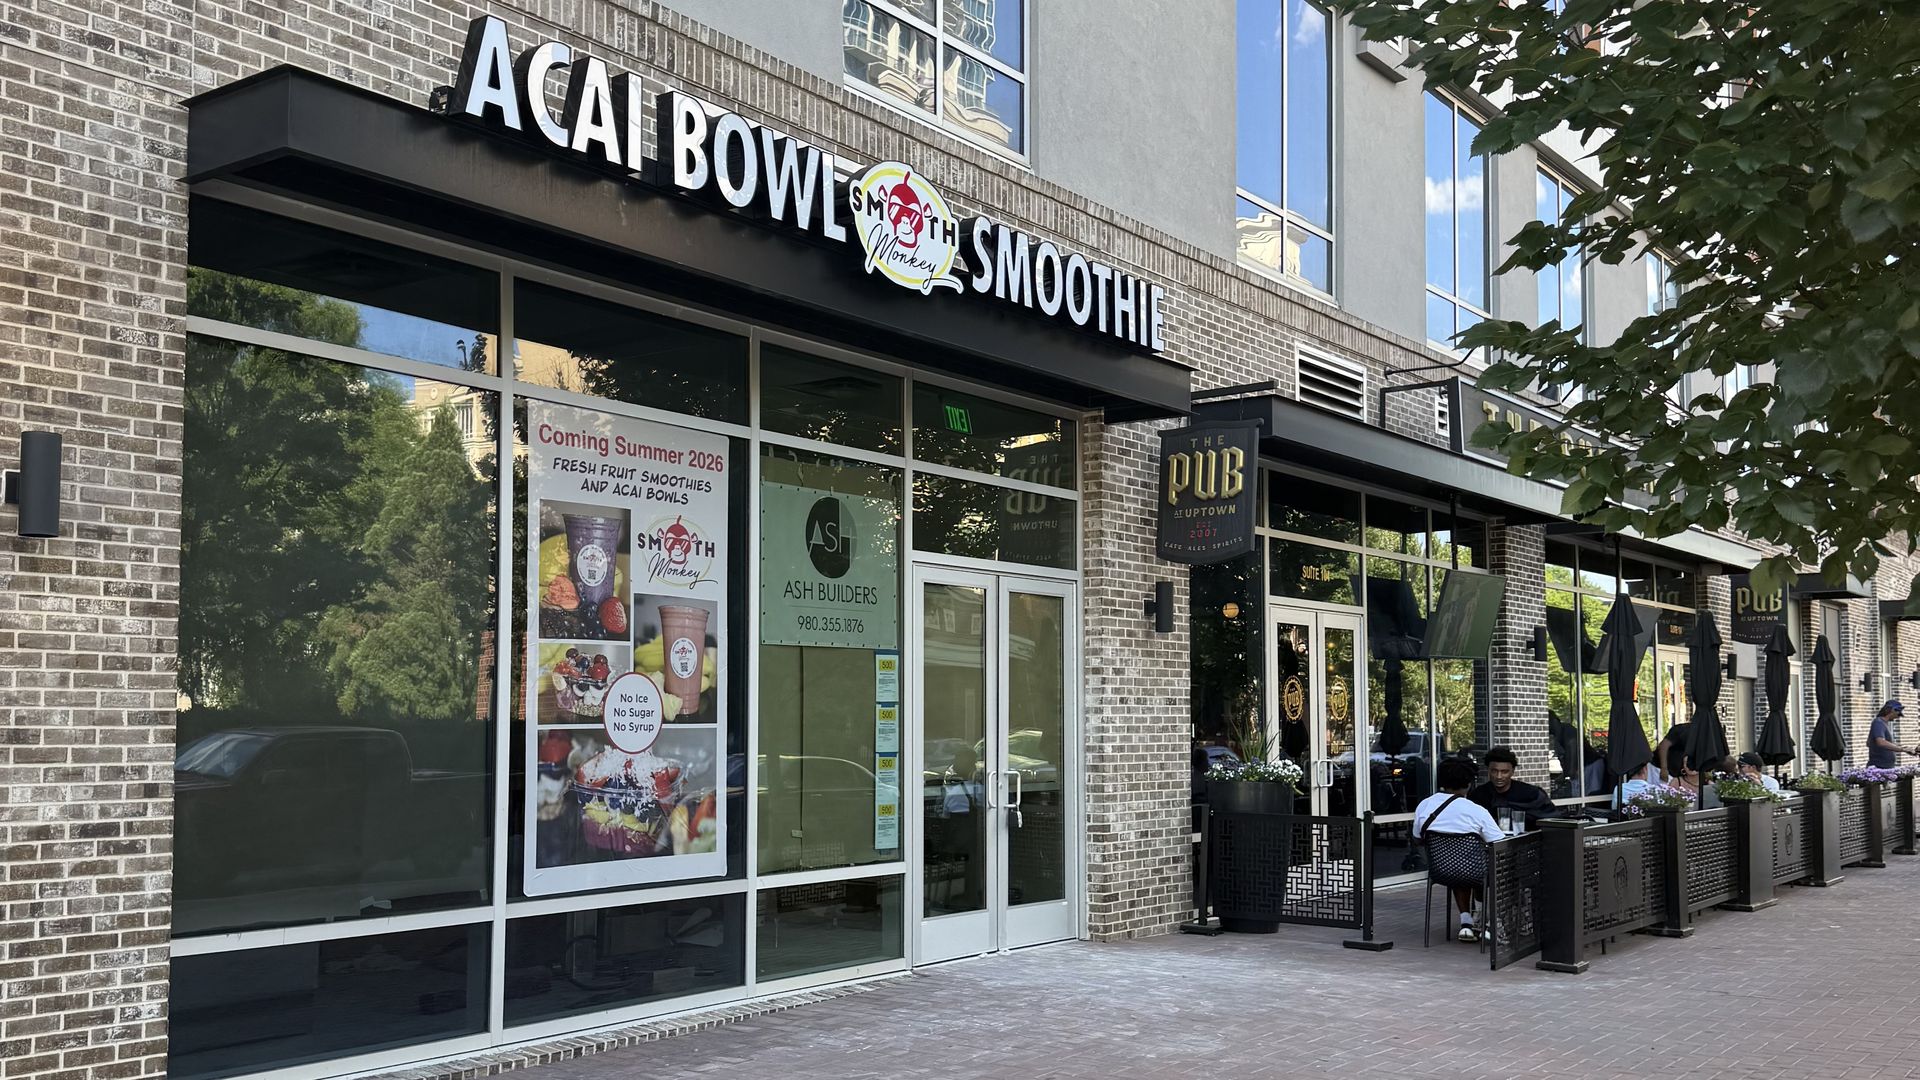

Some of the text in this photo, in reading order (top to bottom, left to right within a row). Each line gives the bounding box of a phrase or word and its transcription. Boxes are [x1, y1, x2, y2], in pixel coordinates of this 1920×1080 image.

[464, 16, 847, 243] ACAI BOWL
[867, 223, 961, 290] Monkey
[972, 216, 1165, 352] SMOOTHIE
[538, 423, 724, 473] Coming Summer 2026
[1190, 435, 1225, 448] THE
[552, 457, 712, 493] FRESH FRUIT SMOOTHIES
[1168, 446, 1244, 505] PUB
[580, 478, 689, 505] AND ACAI BOWLS
[1185, 504, 1236, 518] UPTOWN
[1189, 528, 1217, 538] 2007
[648, 552, 718, 589] Monkey
[1302, 565, 1320, 580] SUITE
[783, 580, 878, 605] ASH BUILDERS
[797, 615, 864, 633] 980.355.1876
[881, 660, 893, 669] 500
[620, 693, 648, 703] No Ice
[613, 707, 655, 719] No Sugar
[881, 710, 893, 719] 500
[613, 721, 655, 733] No Syrup
[881, 759, 893, 768] 500
